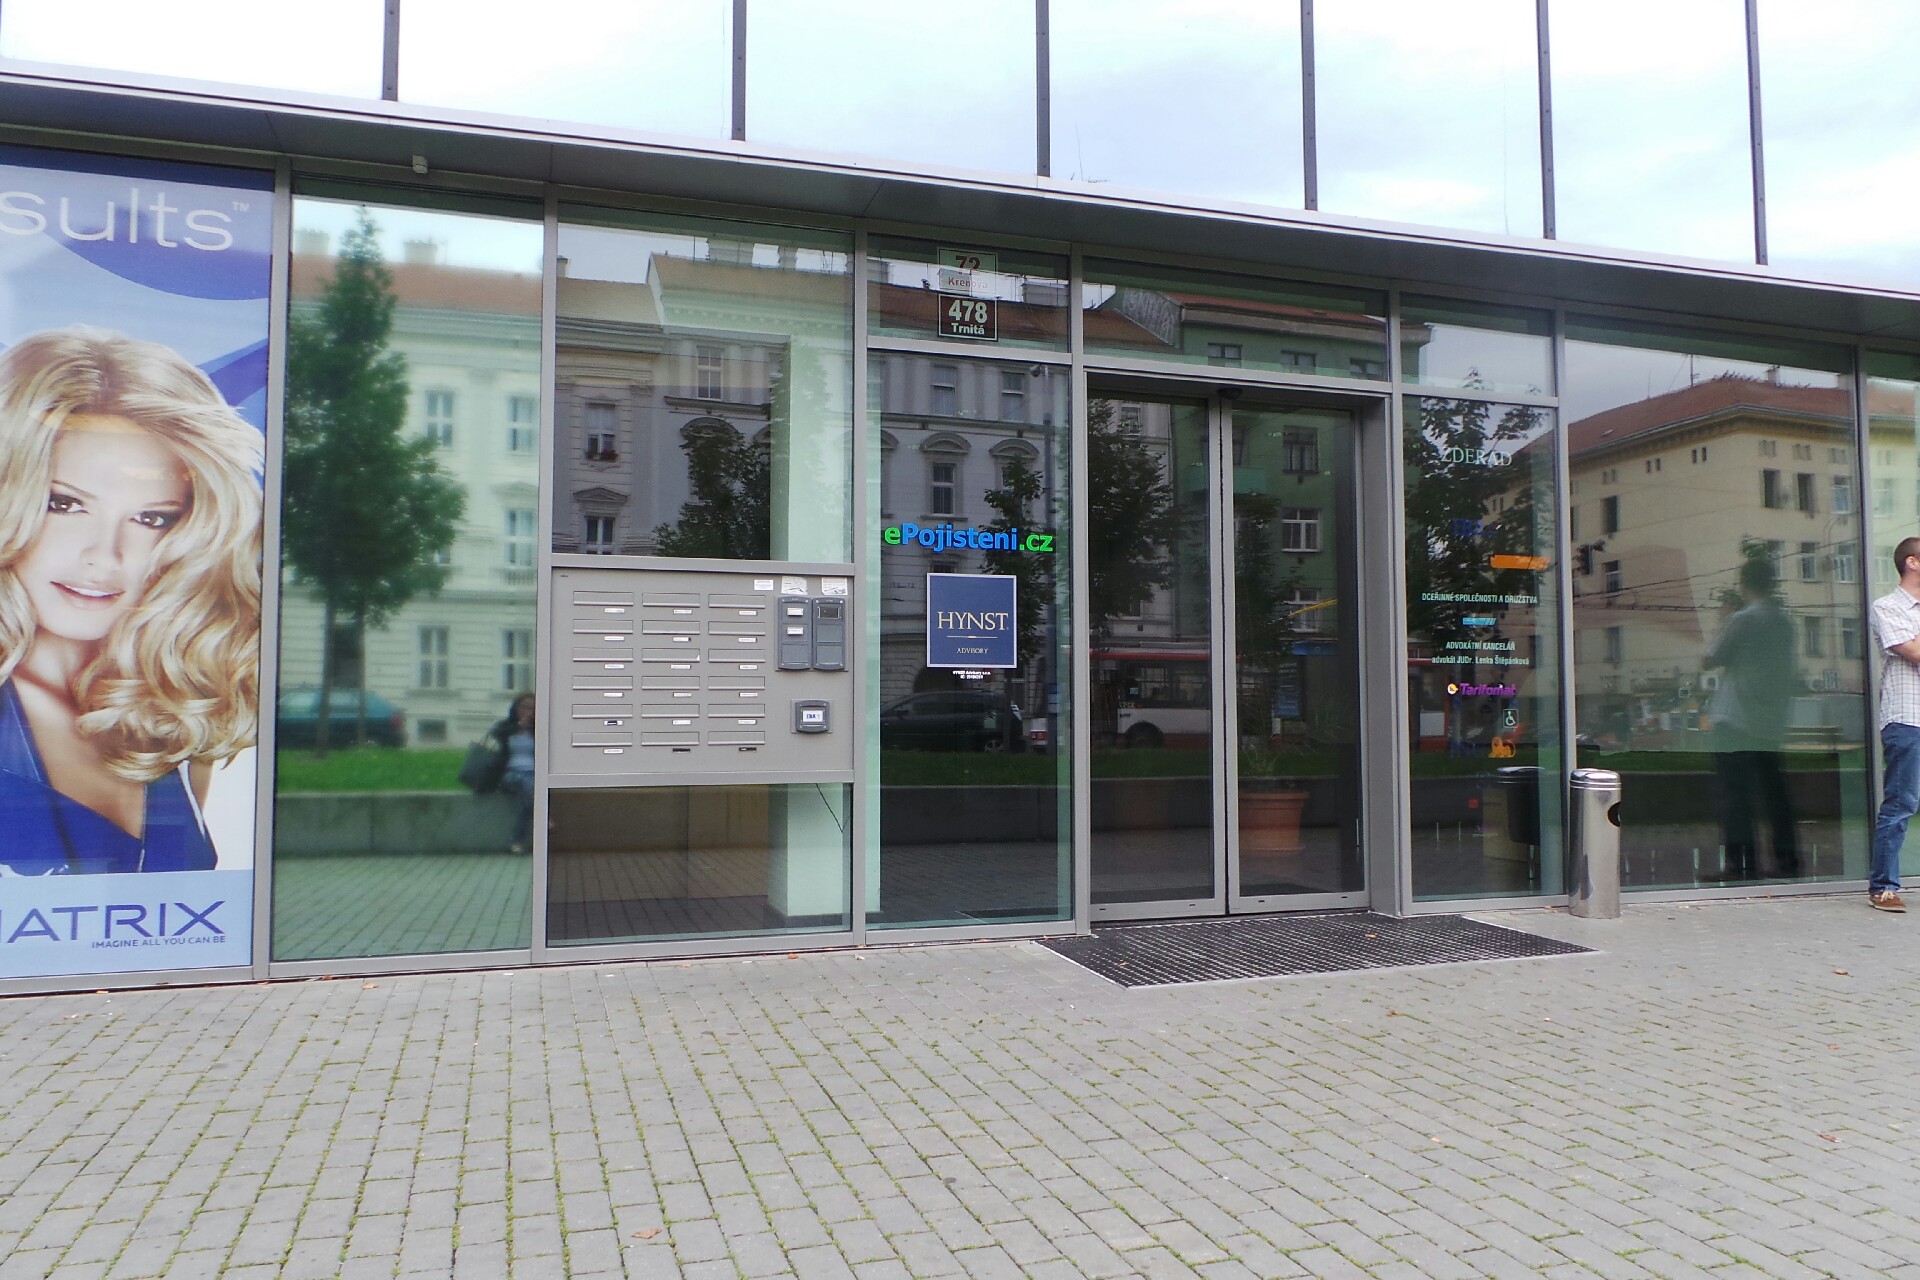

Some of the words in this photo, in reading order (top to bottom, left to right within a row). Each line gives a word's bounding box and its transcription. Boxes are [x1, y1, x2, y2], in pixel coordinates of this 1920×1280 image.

[955, 255, 981, 275] 72
[948, 299, 988, 324] 478
[951, 322, 985, 335] Trnitá
[1440, 447, 1512, 466] ZDERAD
[884, 522, 1054, 552] ePojisteni.cz
[1455, 592, 1498, 603] SPOLEČNOSTI
[1498, 595, 1504, 603] A
[1504, 595, 1538, 604] DRUŽSTVA
[937, 611, 1009, 631] HYNST
[1445, 640, 1482, 650] ADVOKÁTNÍ
[1482, 640, 1516, 651] KANCELÁŘ
[1456, 655, 1475, 664] JUDr.
[1475, 655, 1494, 665] Lenka
[1494, 655, 1530, 666] Štěpánková
[0, 900, 226, 944] ATRIX
[92, 939, 139, 949] IMAGINE
[142, 938, 161, 947] ALL
[163, 937, 186, 946] YOU
[188, 936, 210, 945] CAN
[213, 935, 226, 944] BE
